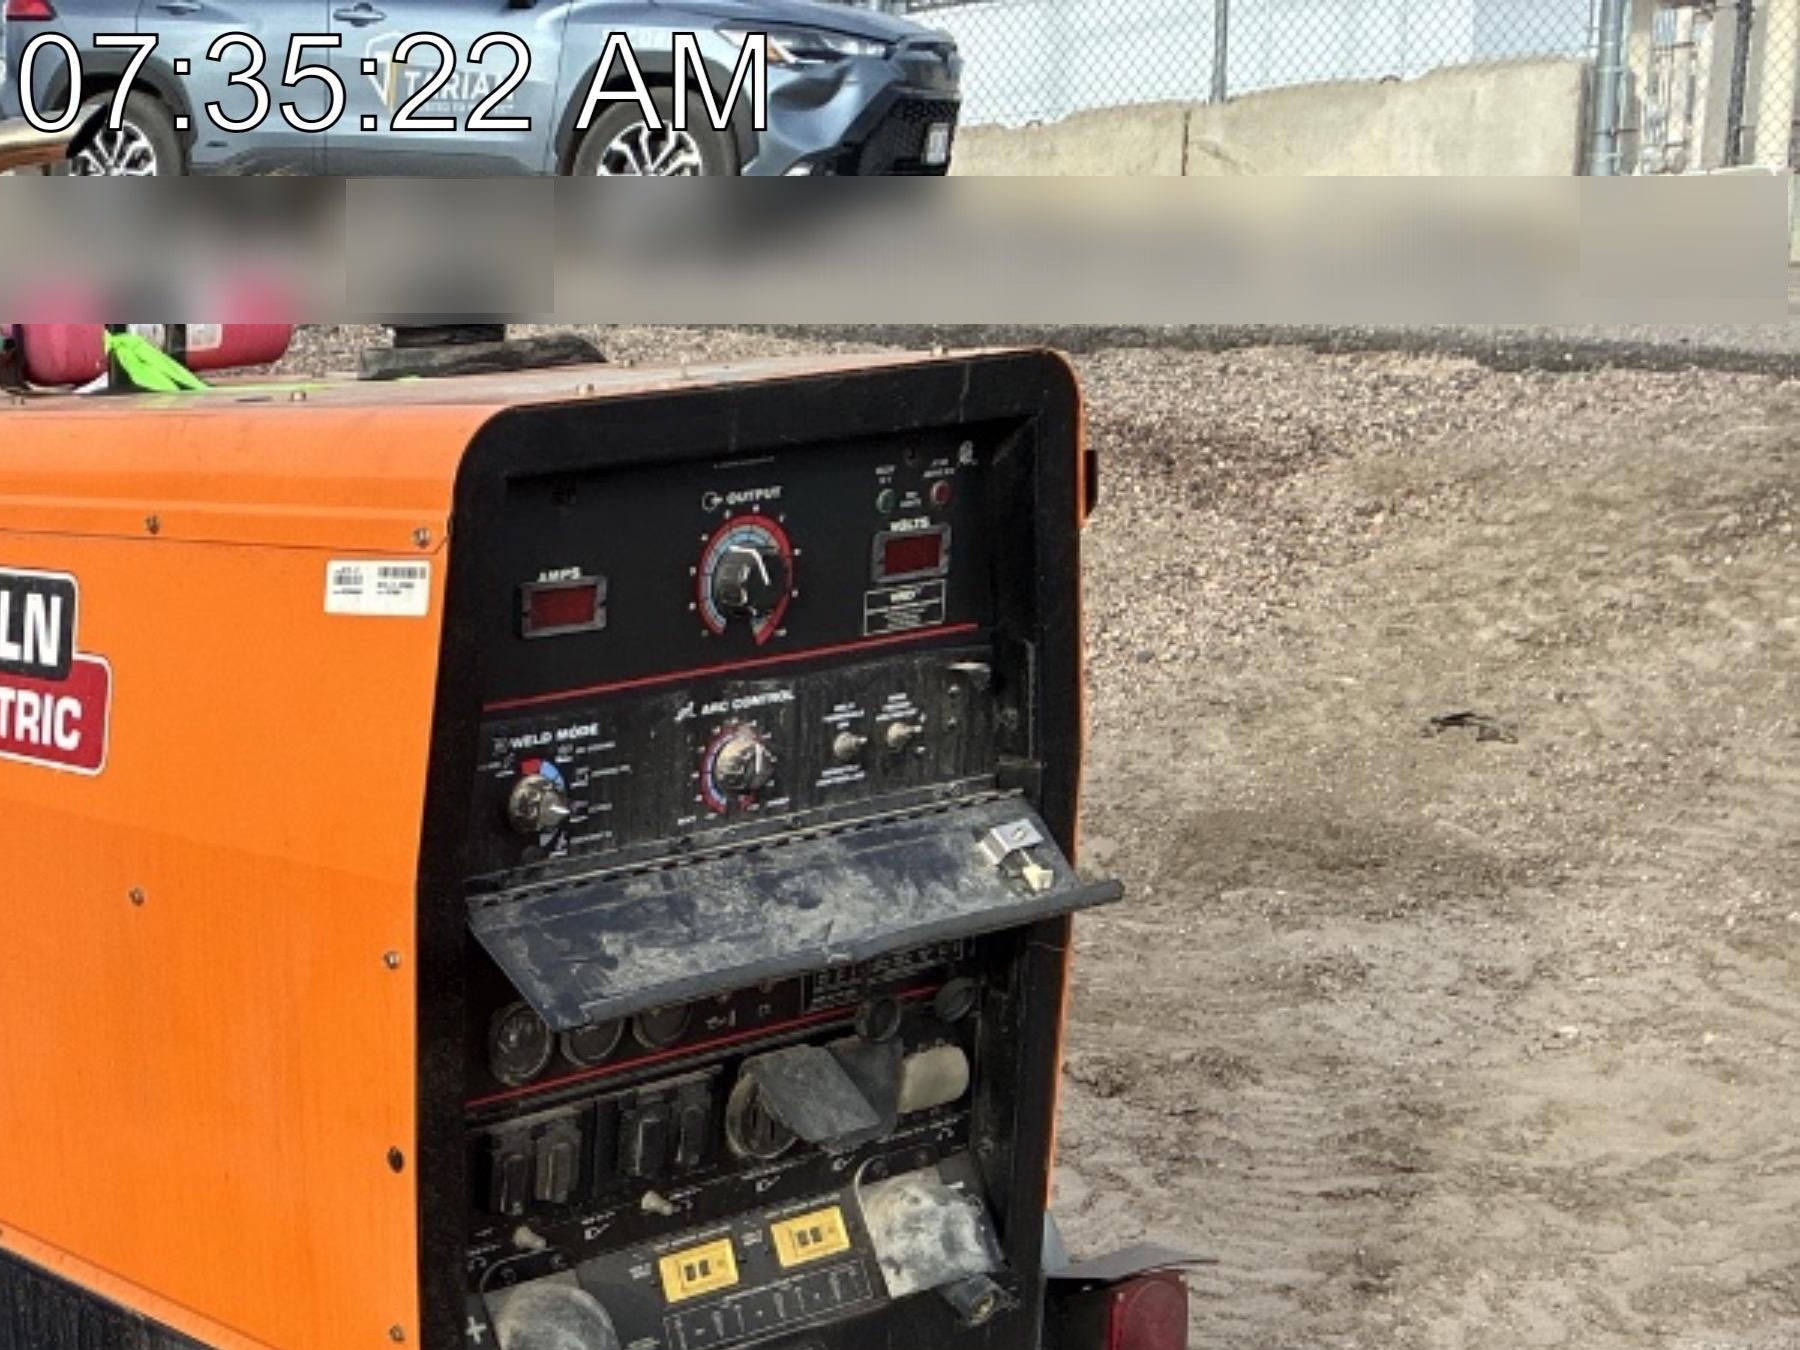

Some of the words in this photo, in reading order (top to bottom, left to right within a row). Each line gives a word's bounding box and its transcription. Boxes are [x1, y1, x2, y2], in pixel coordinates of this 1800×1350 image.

[725, 486, 782, 504] OUTPUT
[536, 566, 581, 583] AMPS
[510, 731, 552, 749] WELD
[555, 721, 600, 741] MODE
